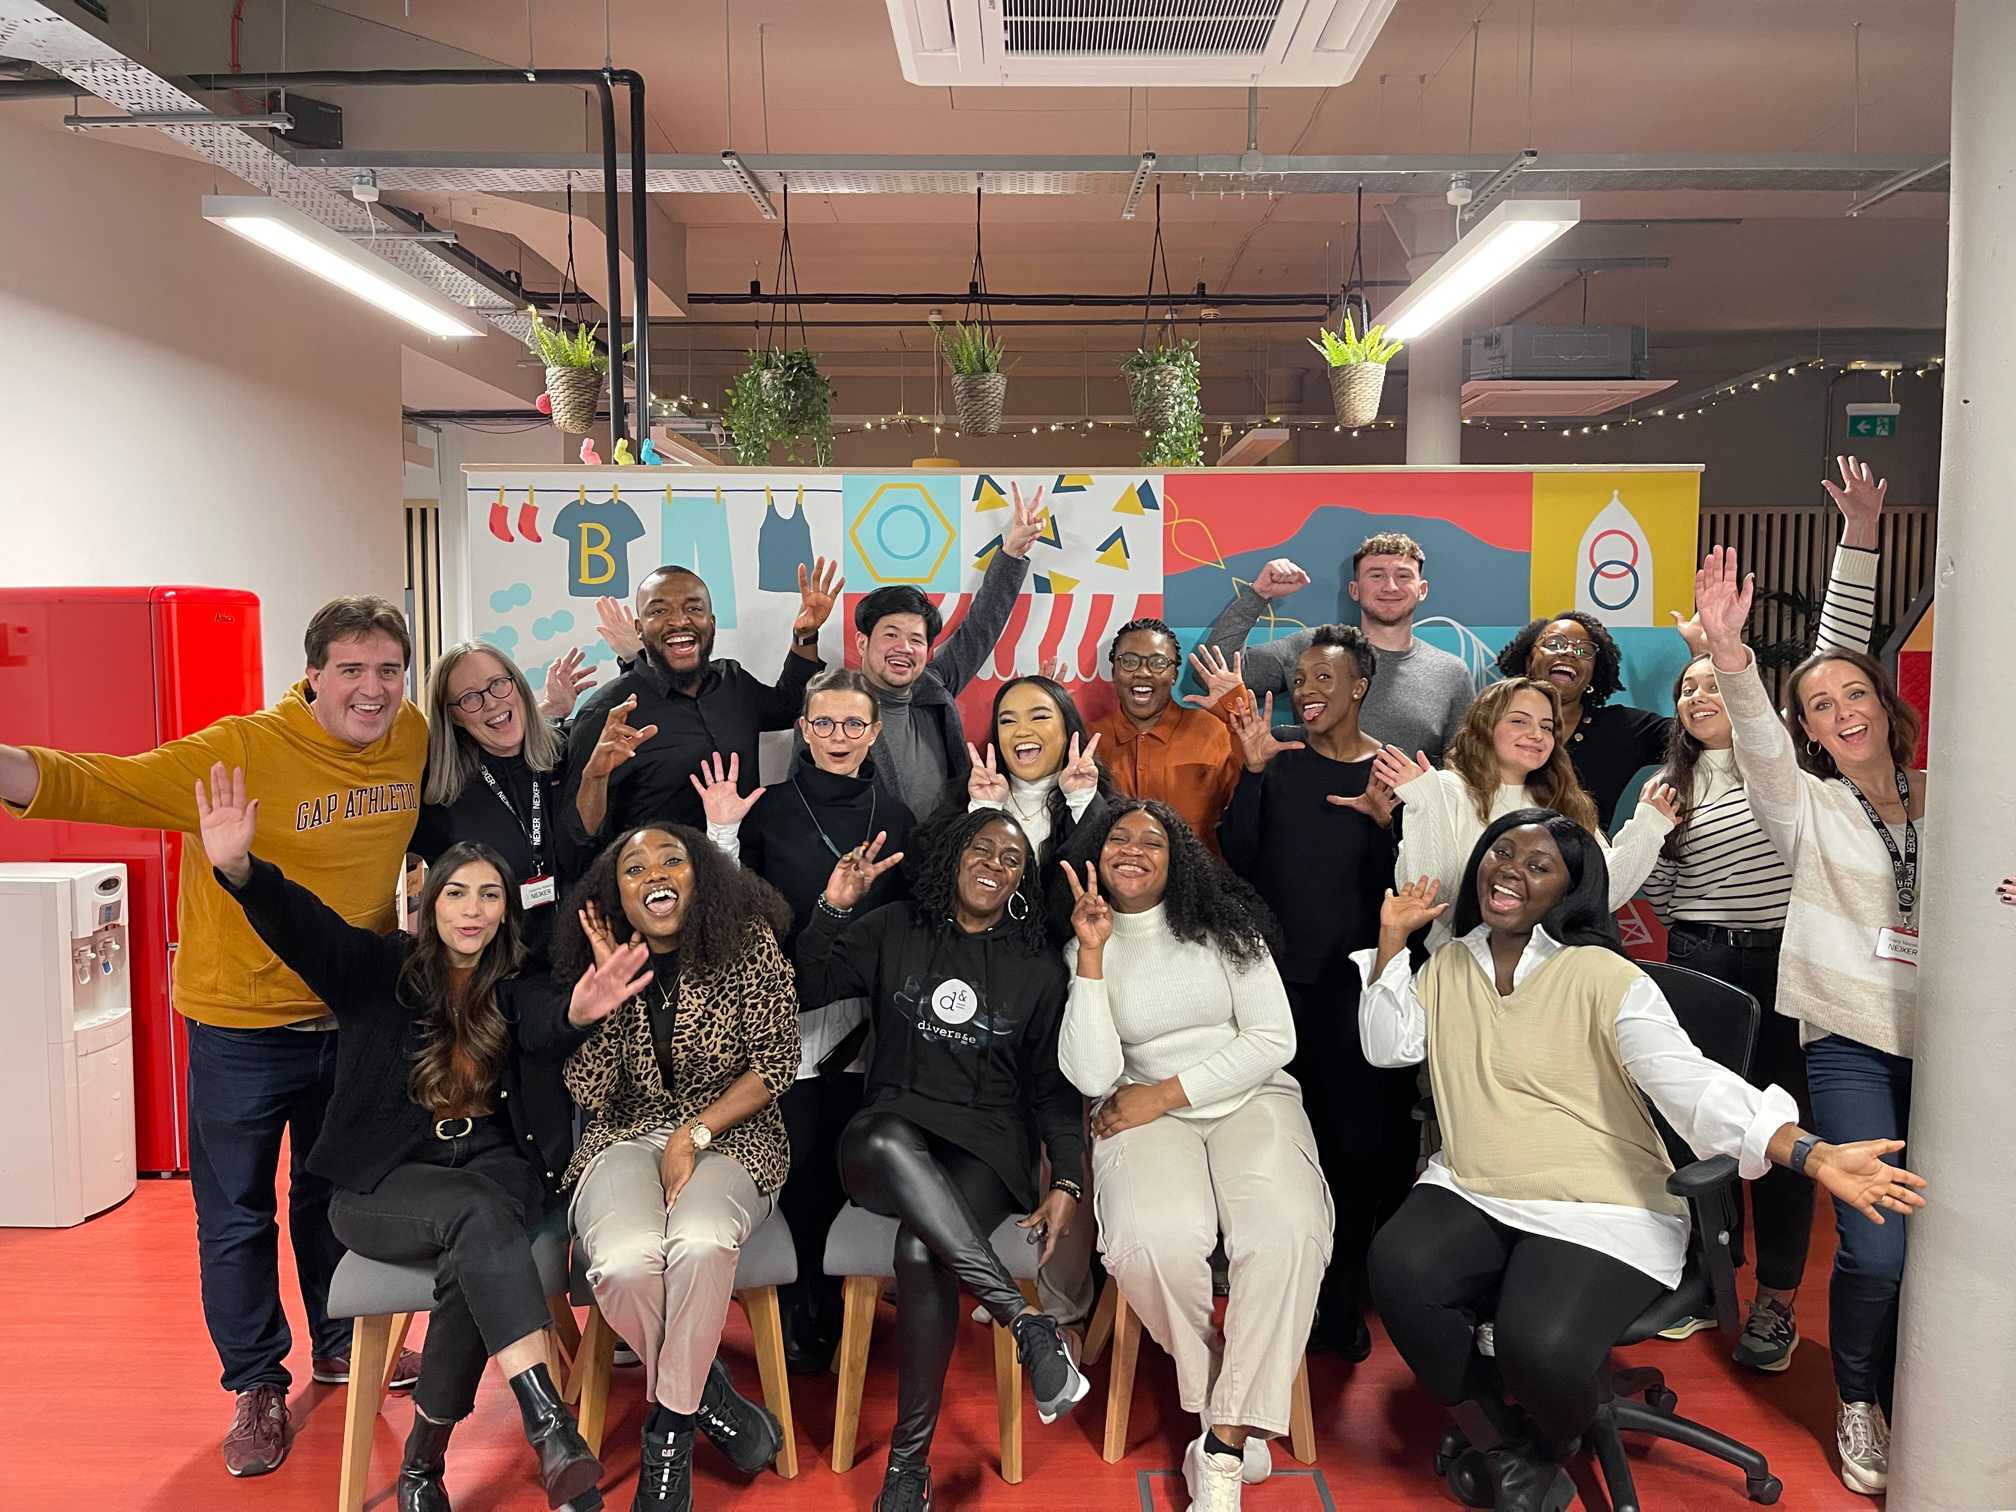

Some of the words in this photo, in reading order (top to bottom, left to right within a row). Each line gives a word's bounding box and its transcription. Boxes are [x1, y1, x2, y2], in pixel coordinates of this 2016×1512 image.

[578, 522, 616, 585] B
[296, 793, 339, 832] GAP
[344, 782, 418, 819] ATHLETIC
